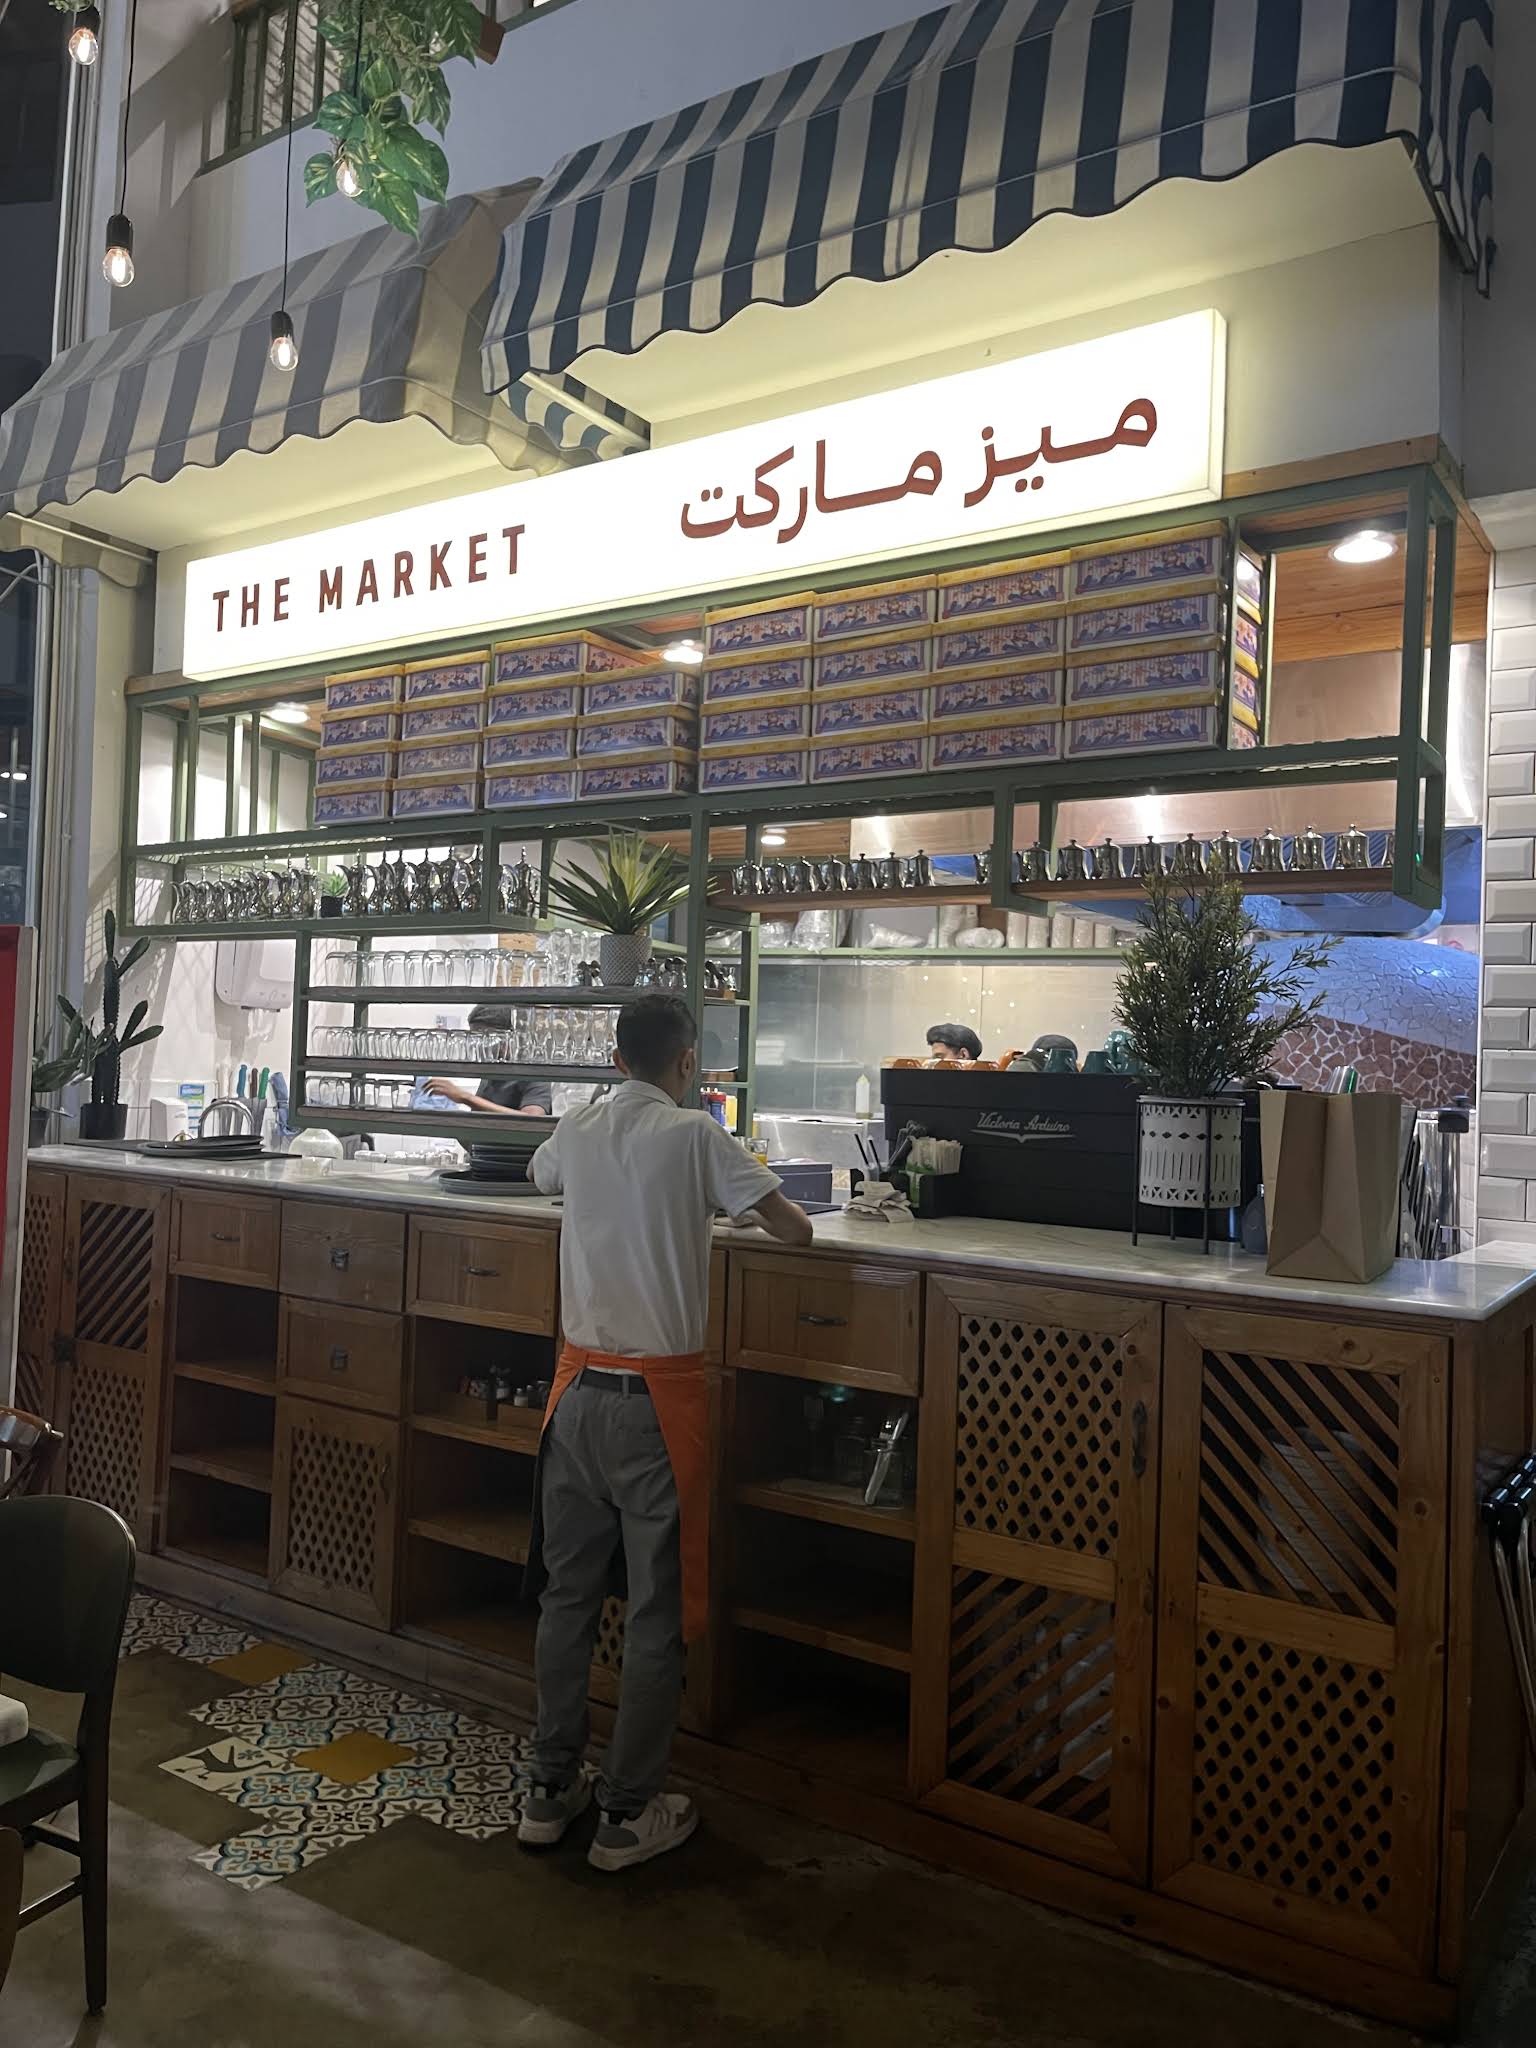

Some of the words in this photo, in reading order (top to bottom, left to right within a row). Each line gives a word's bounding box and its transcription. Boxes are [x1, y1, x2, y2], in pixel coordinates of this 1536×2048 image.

[680, 439, 943, 544] ماركت
[963, 398, 1158, 509] ميز
[212, 576, 290, 633] THE
[318, 523, 525, 614] MARKET
[976, 1111, 1021, 1130] Victoria
[1023, 1114, 1071, 1132] Arduino
